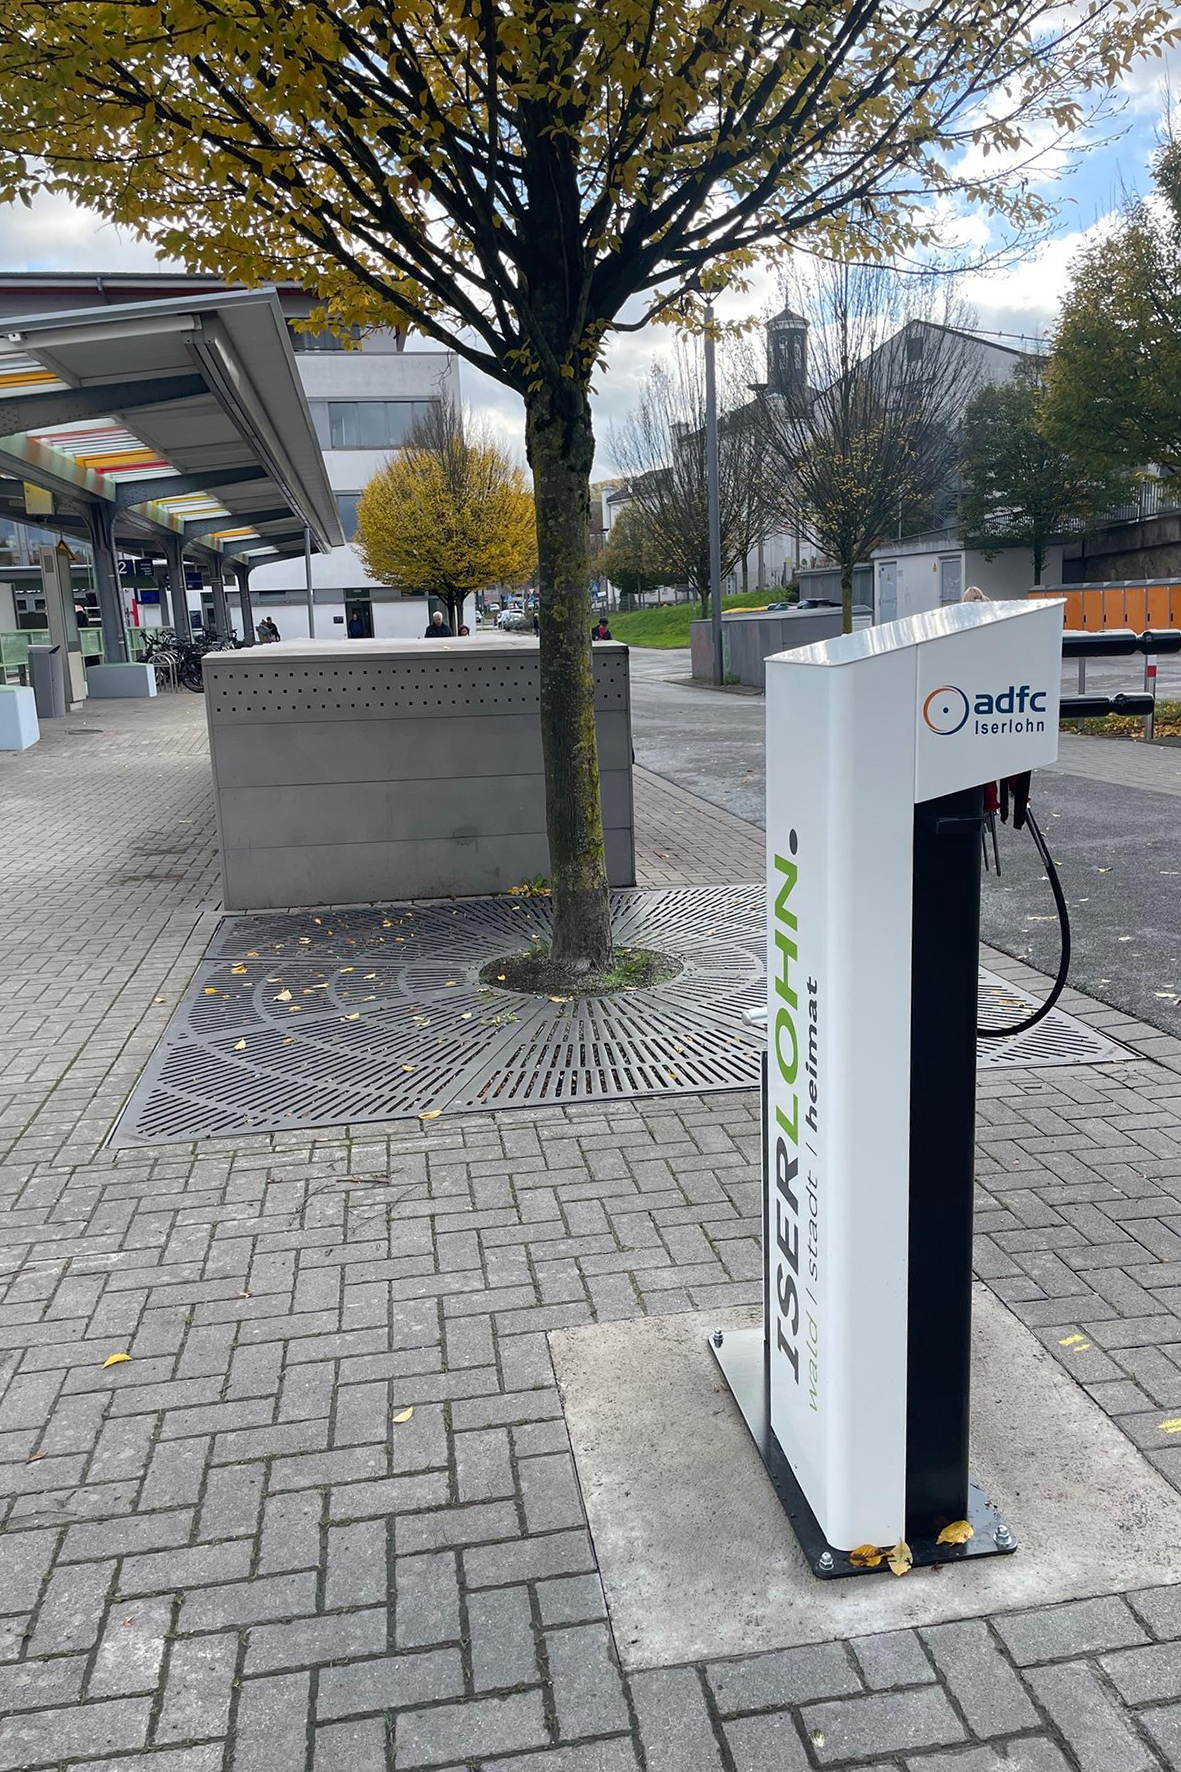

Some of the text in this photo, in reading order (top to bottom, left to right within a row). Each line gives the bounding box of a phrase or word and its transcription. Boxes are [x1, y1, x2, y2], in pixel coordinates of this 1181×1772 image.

[118, 561, 128, 574] 2
[974, 685, 1047, 715] adfc
[975, 718, 1045, 735] Iserlohn
[805, 976, 818, 1133] heimat
[806, 1170, 818, 1282] stadt
[806, 1311, 818, 1411] wald
